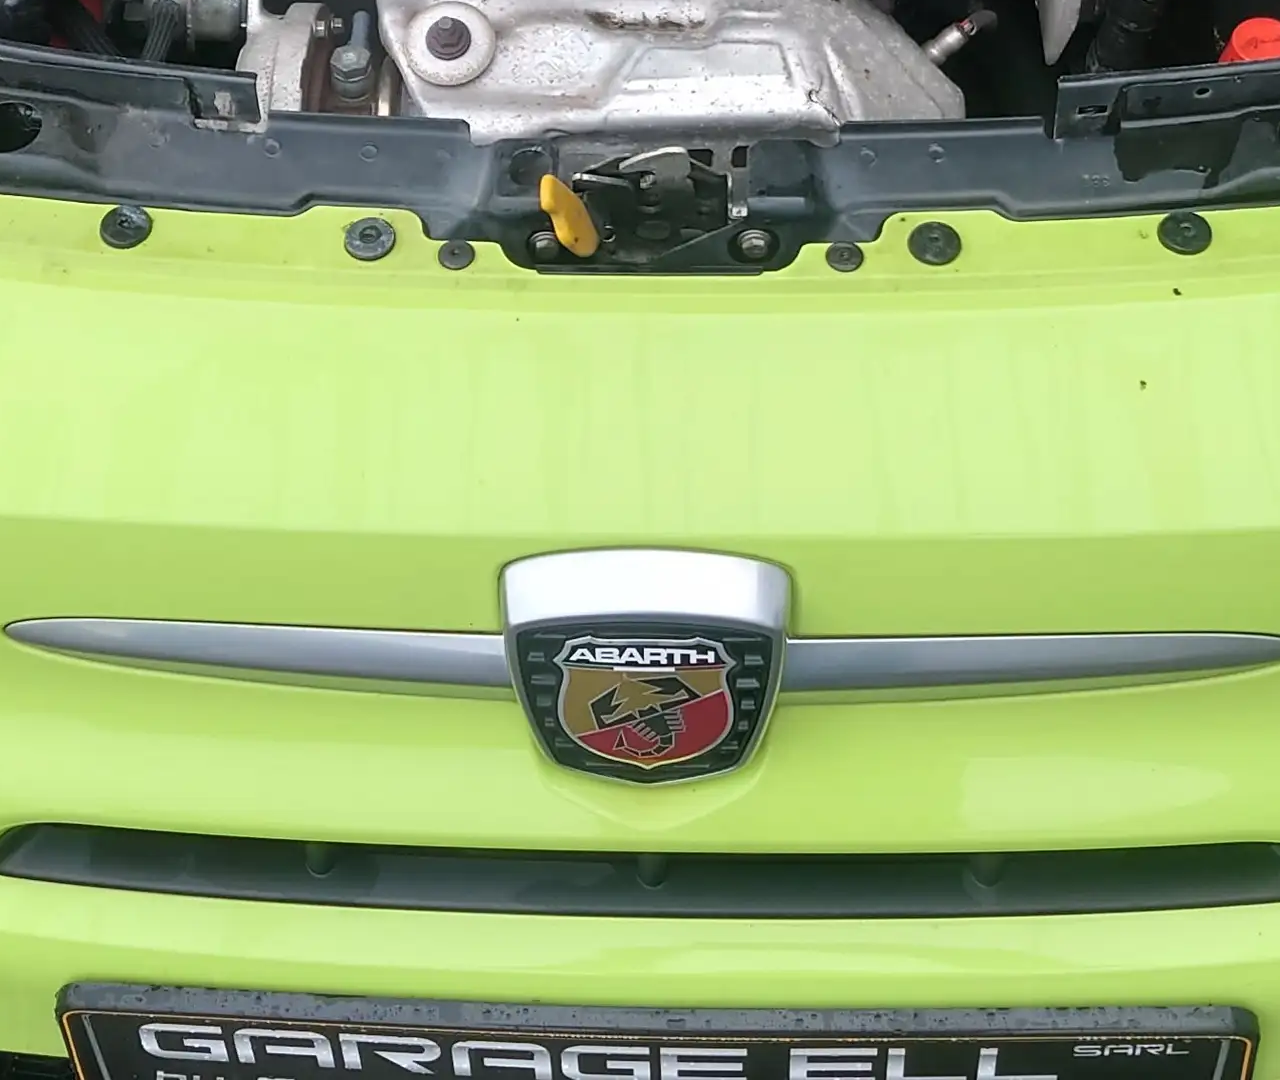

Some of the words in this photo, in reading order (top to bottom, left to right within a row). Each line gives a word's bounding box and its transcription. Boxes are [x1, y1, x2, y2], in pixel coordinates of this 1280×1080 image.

[569, 647, 716, 665] ABARTH
[138, 1022, 748, 1080] GARAGE
[789, 1047, 1058, 1080] ELL
[1073, 1043, 1190, 1057] SARL
